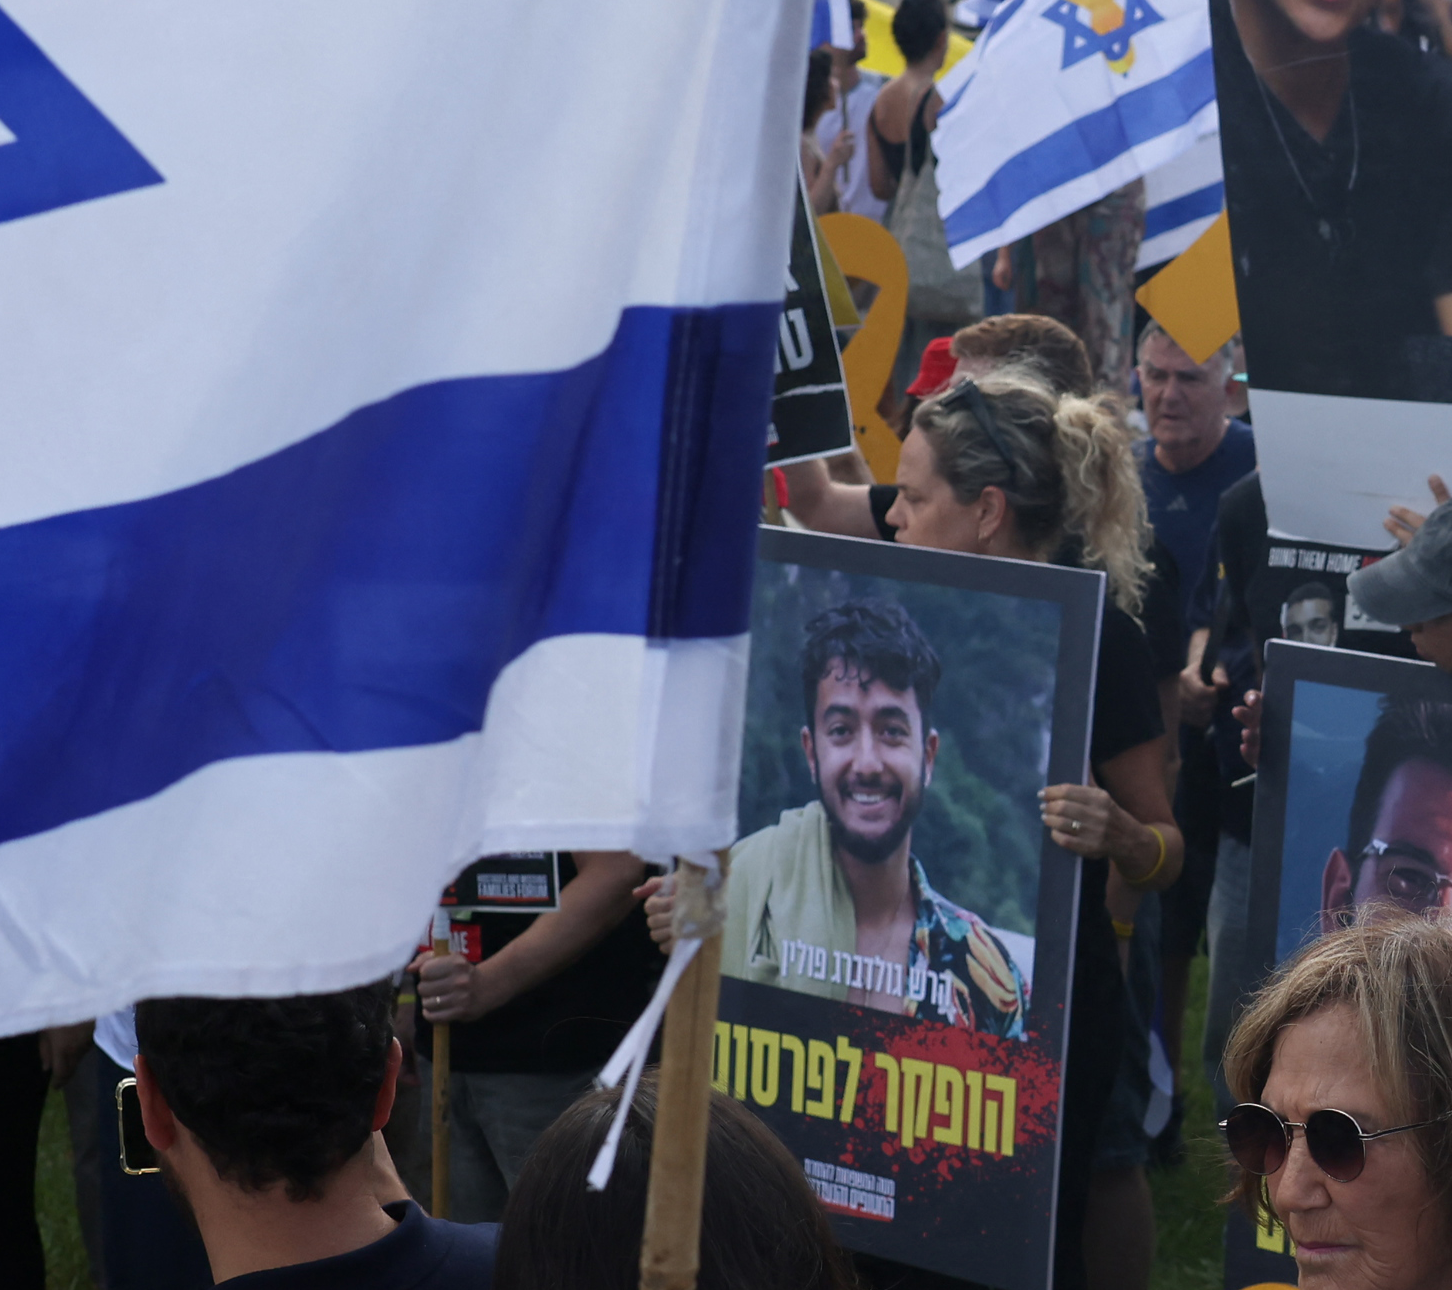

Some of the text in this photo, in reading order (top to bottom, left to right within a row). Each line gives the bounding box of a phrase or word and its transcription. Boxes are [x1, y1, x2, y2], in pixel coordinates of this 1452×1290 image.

[1298, 549, 1327, 571] THEM
[780, 938, 953, 1007] הרש גולדברג פולין
[875, 1052, 1017, 1157] הופקר
